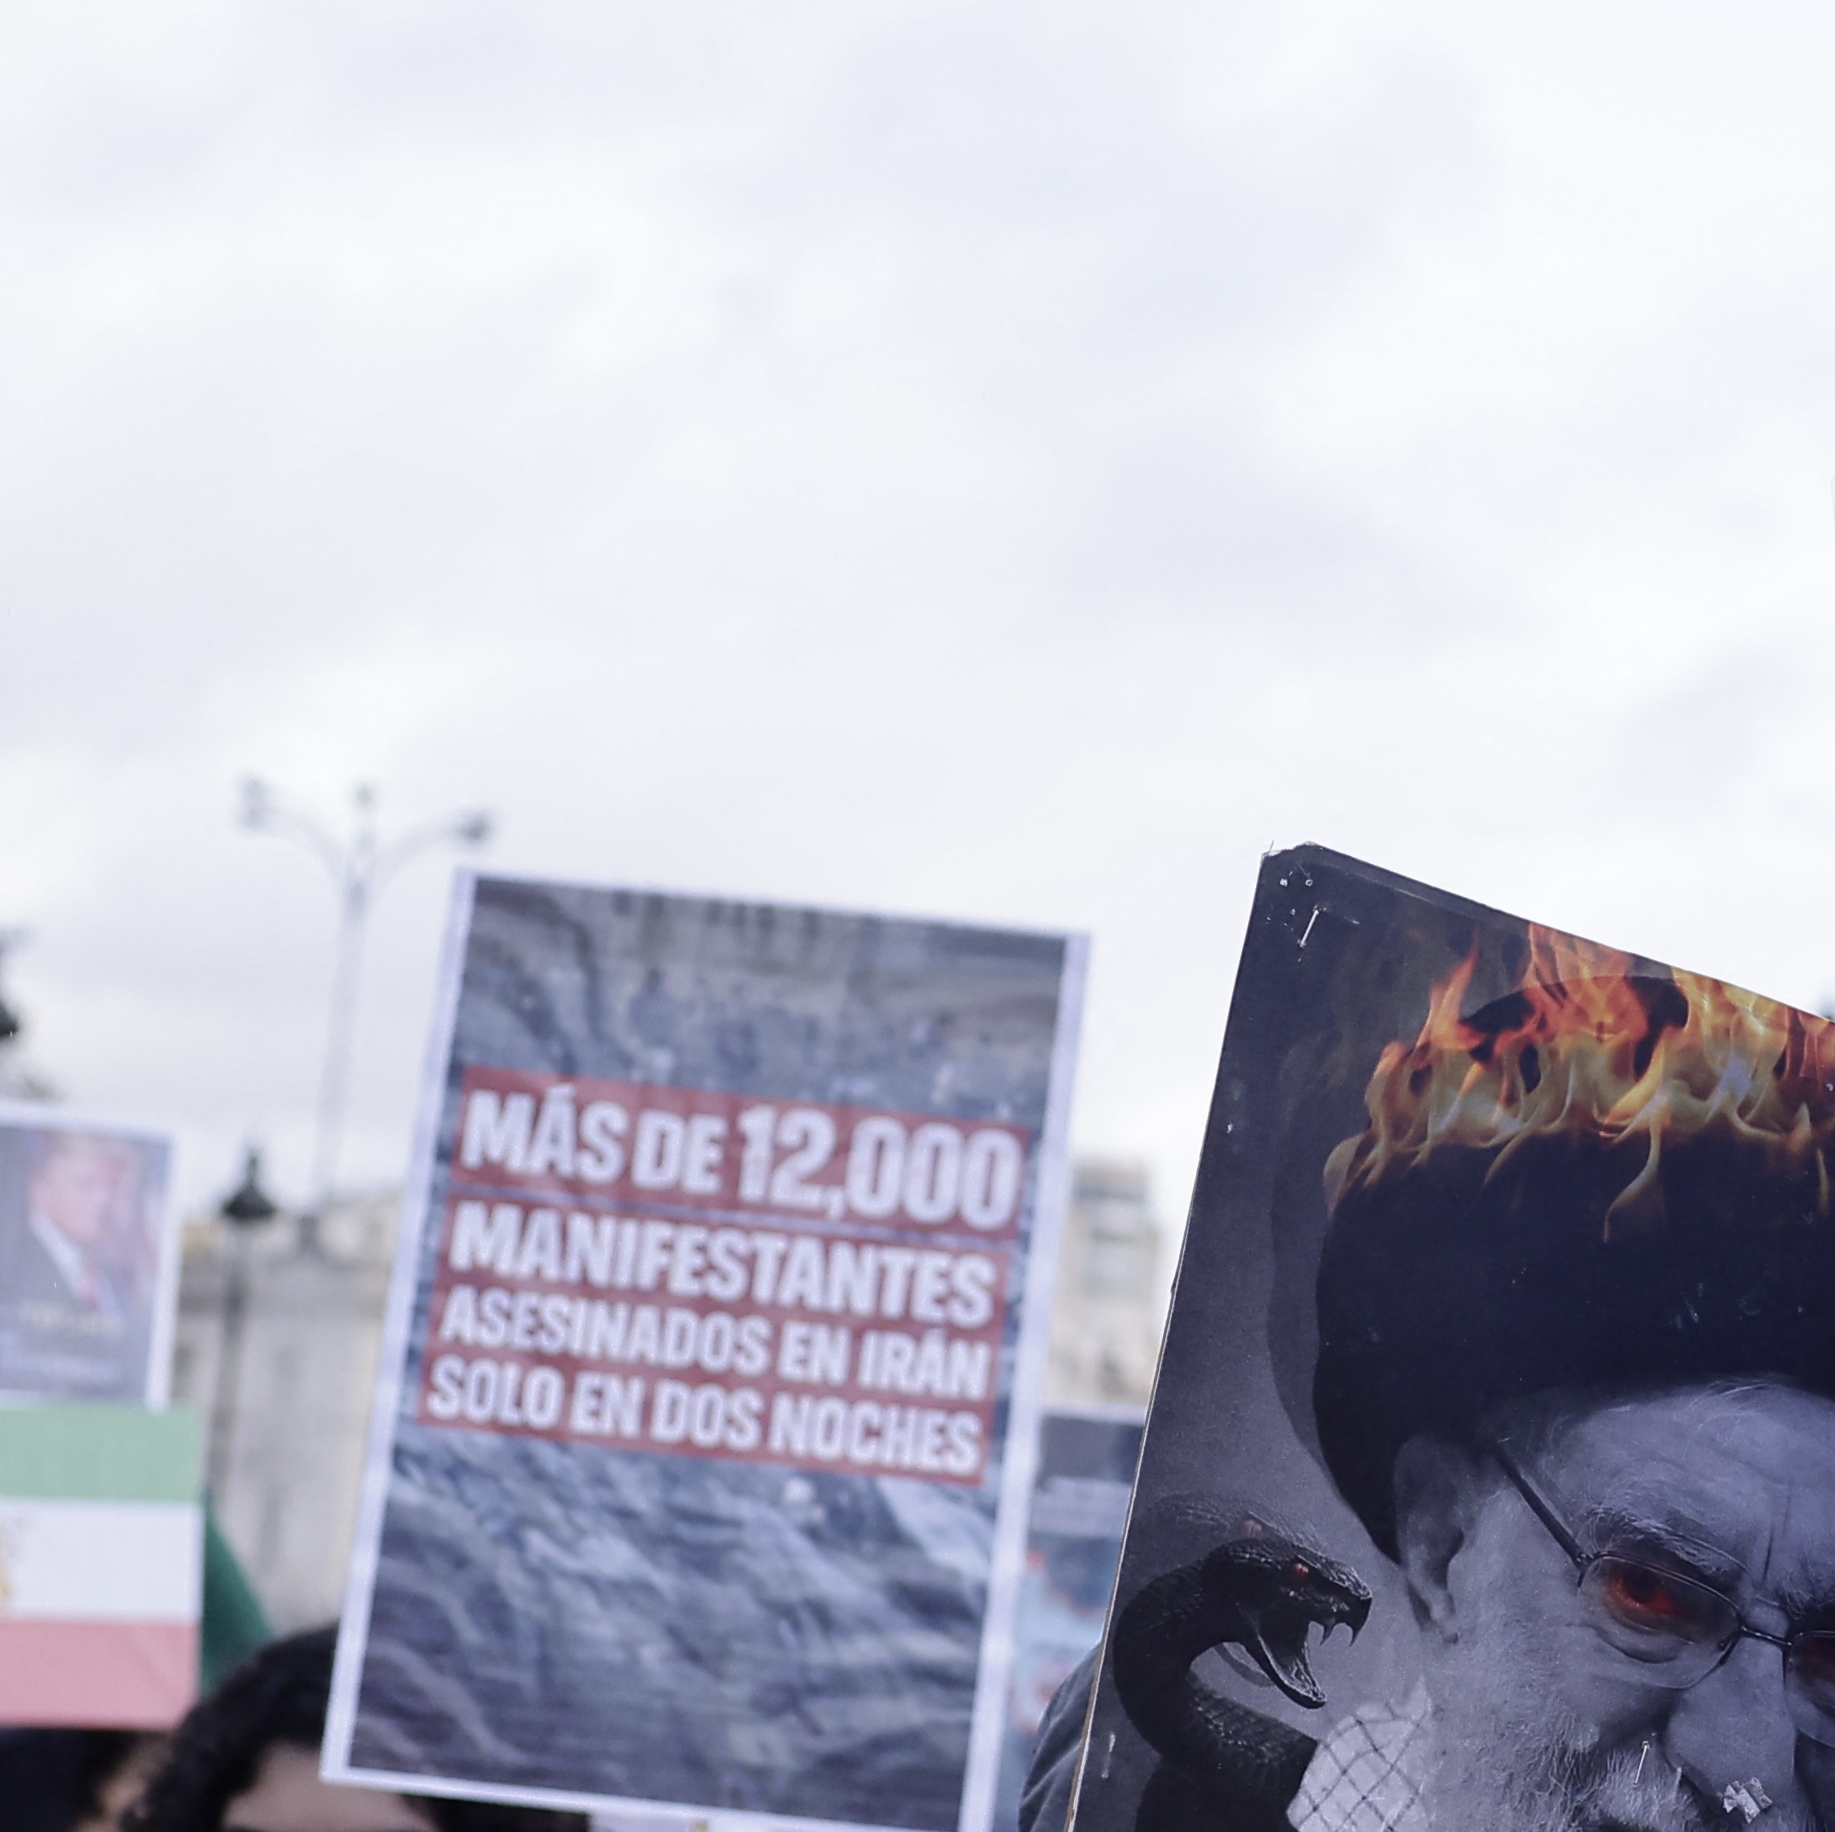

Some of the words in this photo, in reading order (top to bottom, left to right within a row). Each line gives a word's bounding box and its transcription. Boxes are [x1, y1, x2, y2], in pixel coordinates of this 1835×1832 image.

[461, 1081, 629, 1186] MÁS
[630, 1109, 729, 1196] DE
[738, 1104, 1023, 1231] 12,000
[448, 1199, 999, 1329] MANIFESTANTES
[439, 1285, 773, 1378] ASESINADOS
[778, 1319, 851, 1386] EN
[857, 1327, 992, 1401] IRÁN
[425, 1354, 566, 1431] SOLO
[568, 1368, 645, 1437] EN
[649, 1379, 765, 1450] DOS
[767, 1392, 984, 1477] NOCHES
